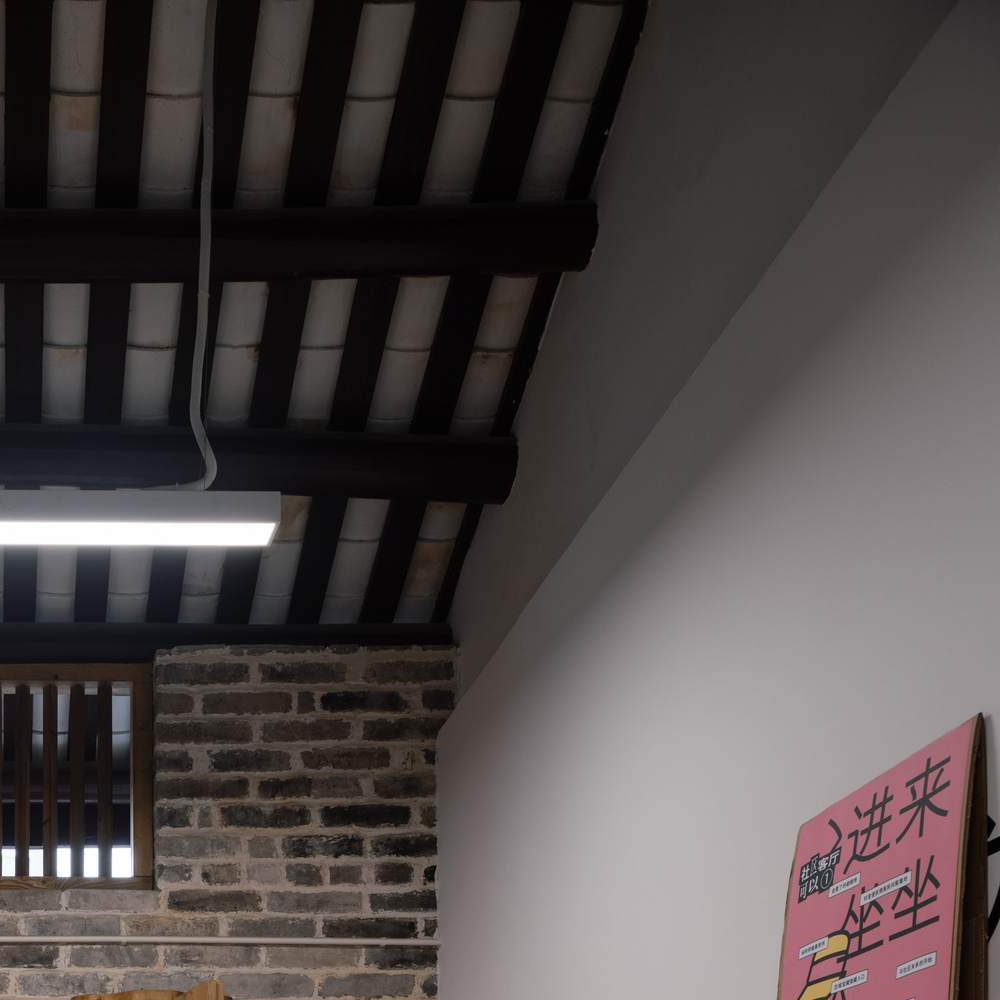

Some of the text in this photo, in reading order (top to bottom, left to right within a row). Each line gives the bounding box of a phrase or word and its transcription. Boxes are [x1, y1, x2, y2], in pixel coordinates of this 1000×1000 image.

[800, 850, 841, 883] 社区客厅
[844, 756, 951, 875] 进来
[837, 855, 940, 964] 坐坐
